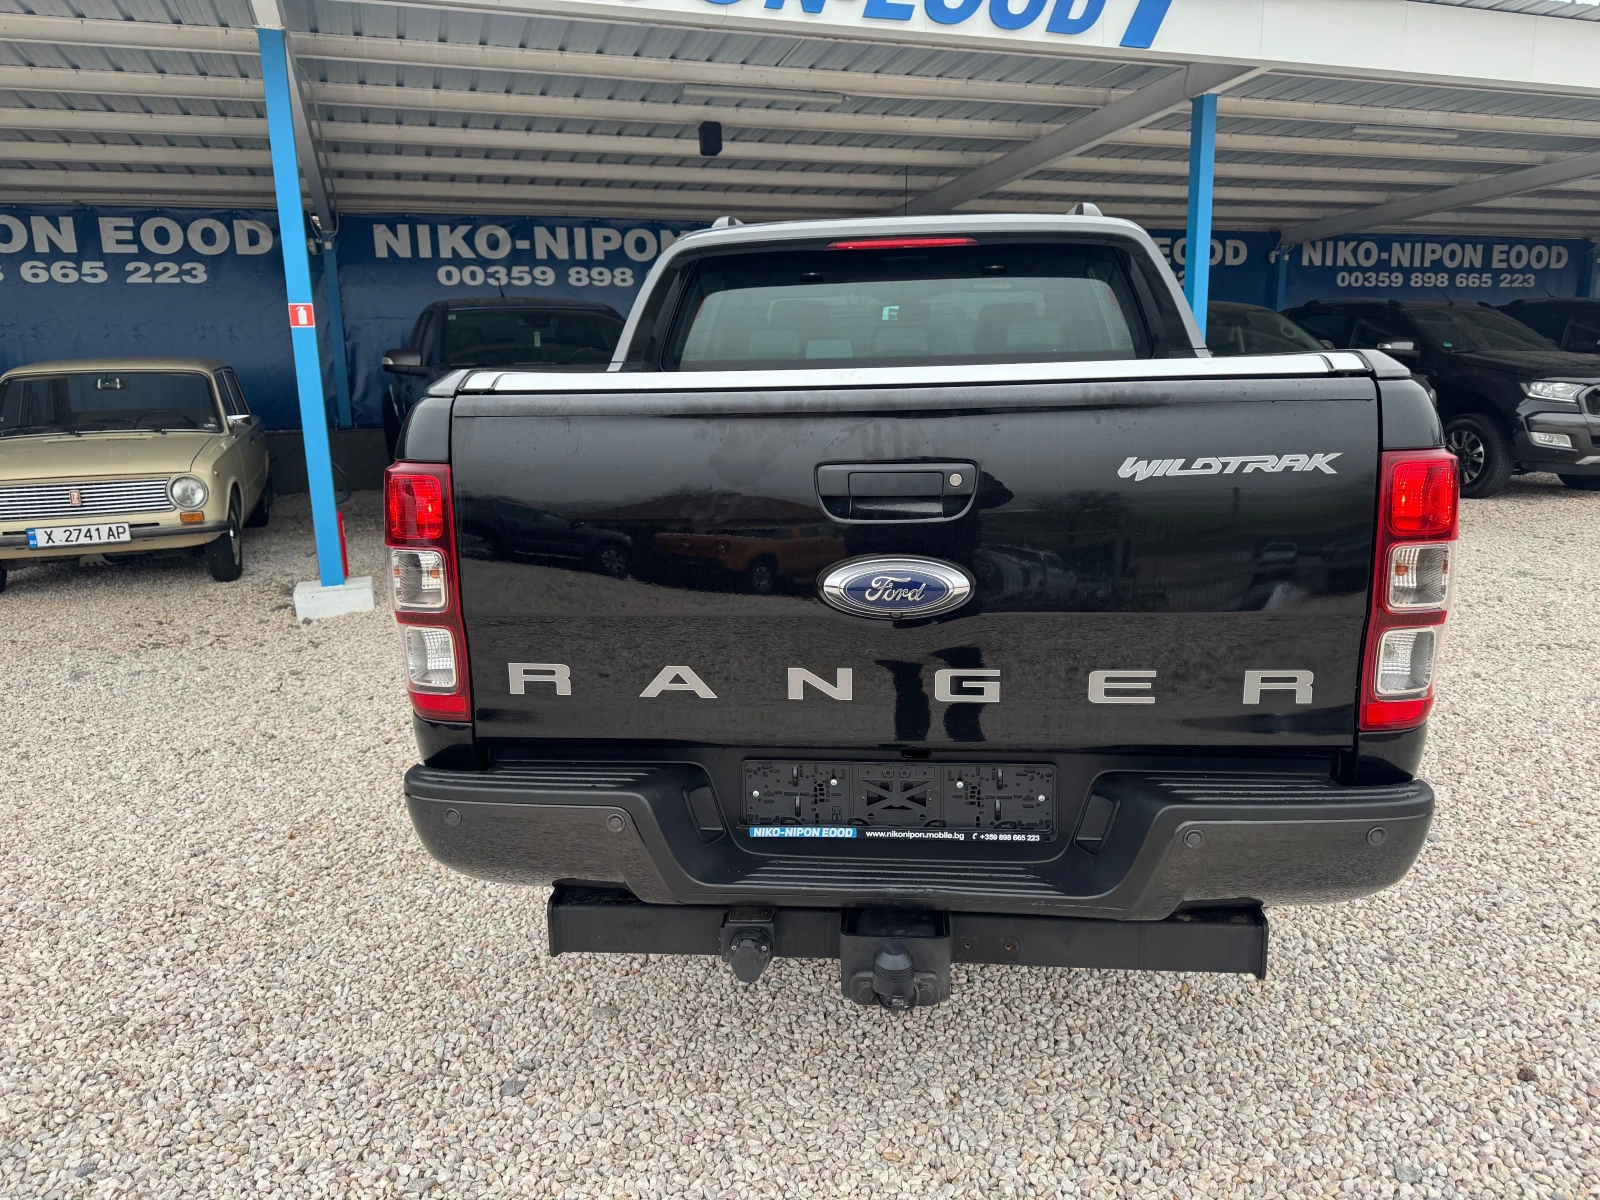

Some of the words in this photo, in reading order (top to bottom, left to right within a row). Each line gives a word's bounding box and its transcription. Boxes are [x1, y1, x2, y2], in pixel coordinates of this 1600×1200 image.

[98, 216, 273, 256] EOOD
[1301, 240, 1484, 269] NIKO-NIPON
[1491, 244, 1569, 270] EOOD
[19, 260, 108, 284] 665
[125, 261, 208, 284] 223
[436, 265, 555, 287] 00359
[567, 266, 635, 287] 898
[1336, 271, 1404, 287] 00359
[1409, 272, 1449, 288] 898
[1455, 272, 1493, 288] 665
[1498, 273, 1536, 288] 223
[1117, 452, 1344, 481] WILDTRAK
[44, 529, 55, 544] X
[63, 528, 101, 542] 2741
[107, 526, 126, 540] AP
[864, 575, 927, 602] Ford
[507, 662, 1315, 705] RANGER
[753, 827, 820, 838] NIKO-NIPON
[821, 828, 854, 838] EOOD
[865, 830, 965, 841] www.nikonipon.mobile.bg
[979, 833, 998, 841] +359
[1026, 834, 1041, 842] 223
